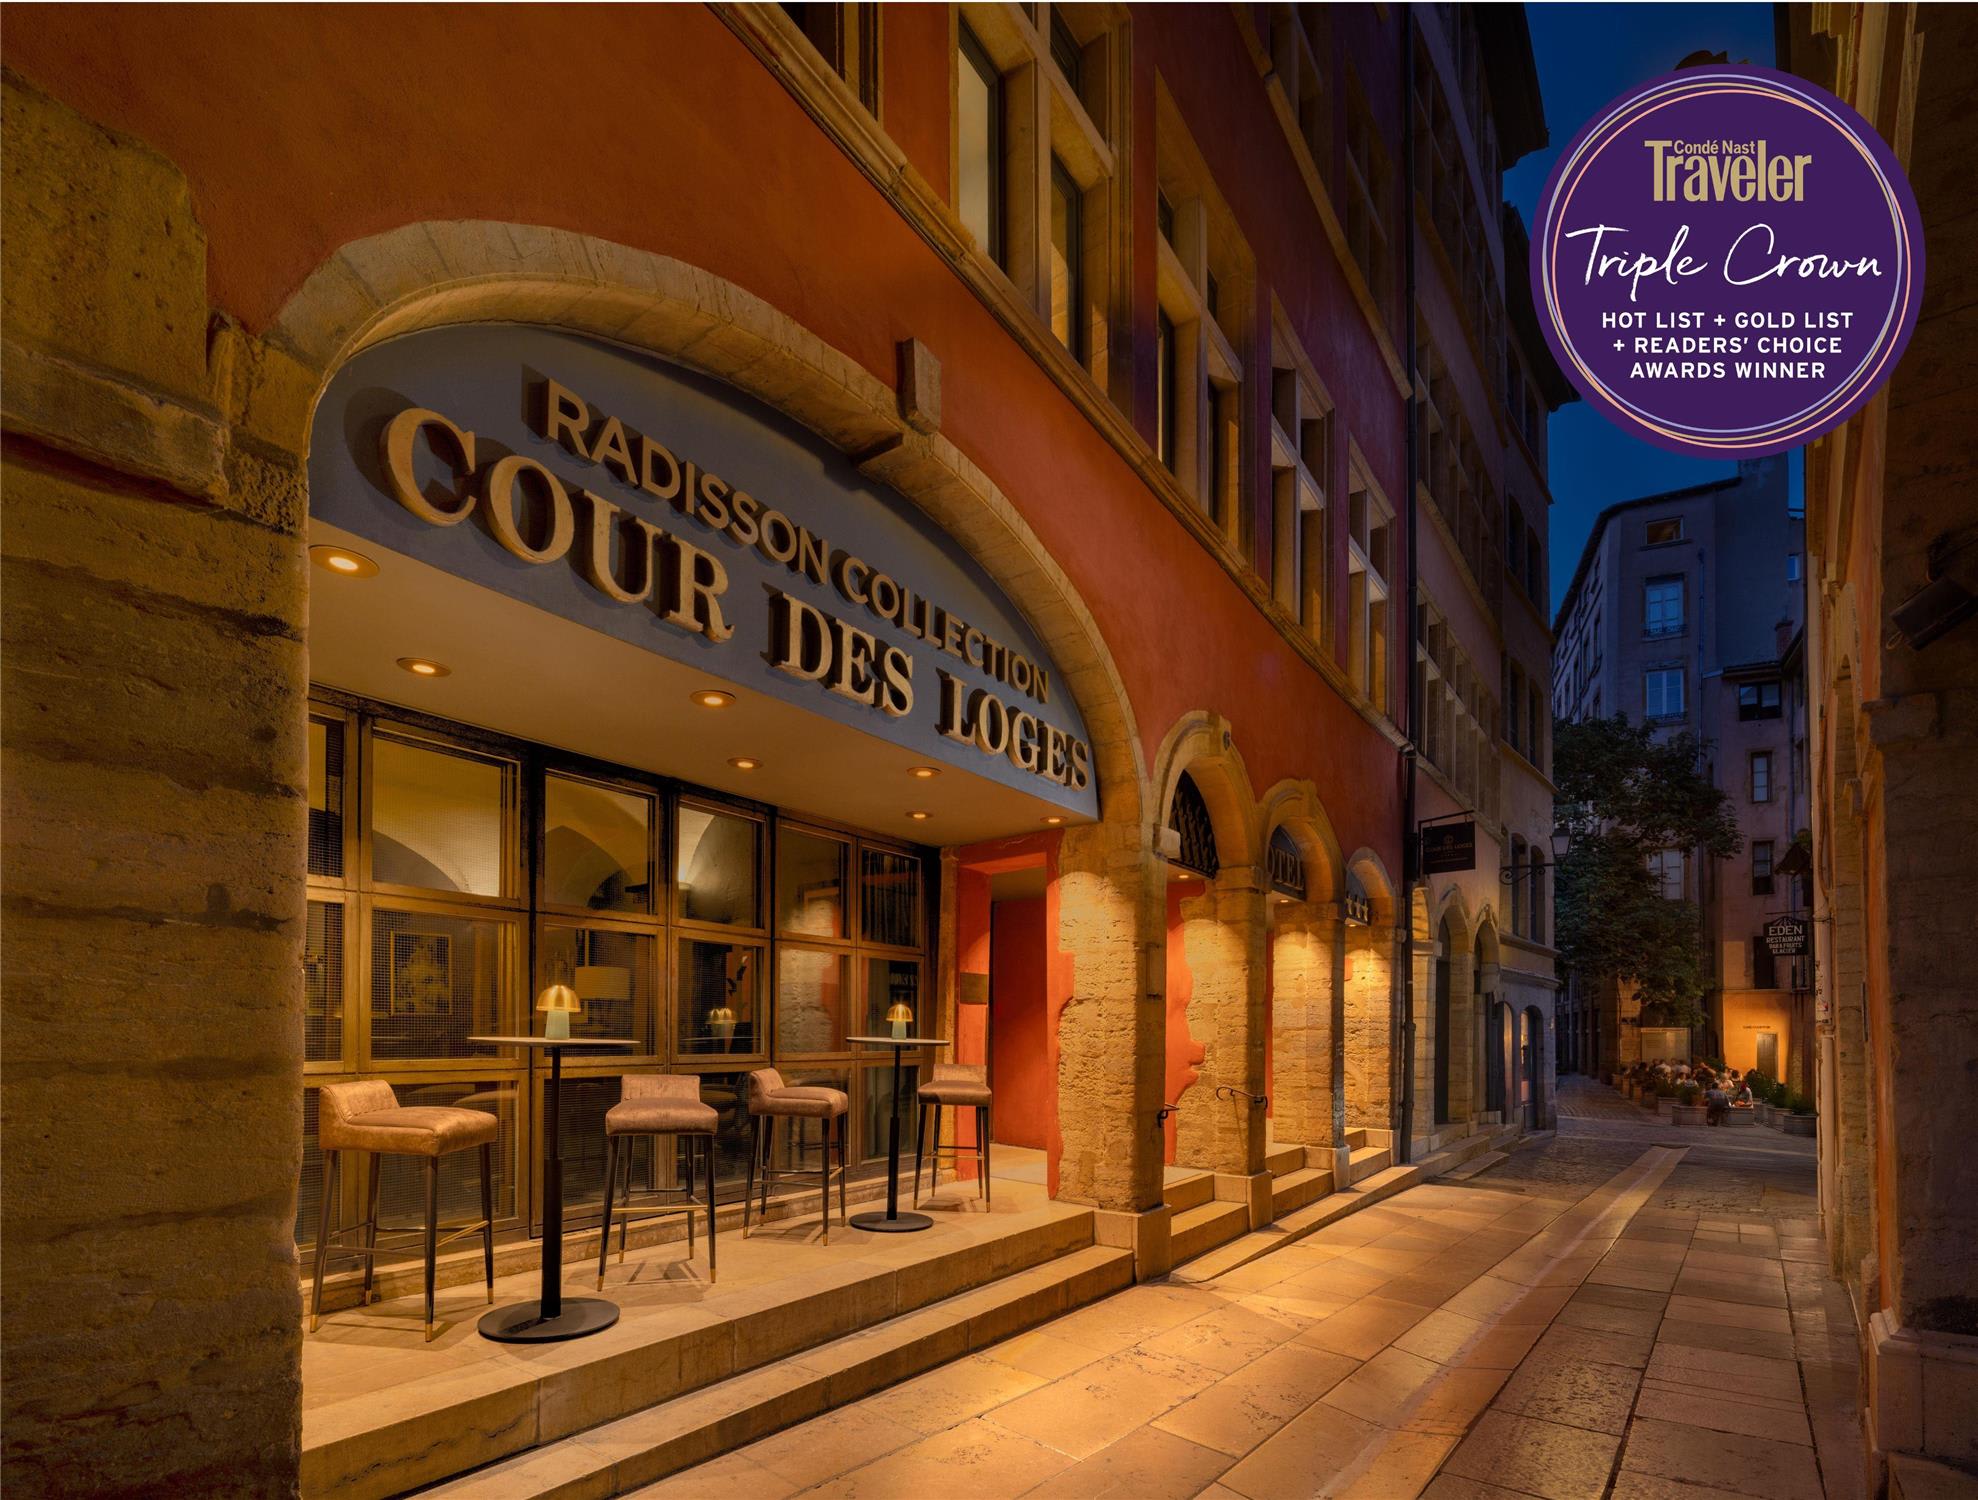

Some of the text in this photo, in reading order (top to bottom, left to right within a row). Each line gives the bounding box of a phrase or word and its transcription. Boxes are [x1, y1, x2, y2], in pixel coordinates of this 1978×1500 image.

[382, 406, 1090, 792] COUR DES LOGES
[546, 377, 1050, 705] RADISSON COLLECTION
[1768, 925, 1803, 936] EDEN
